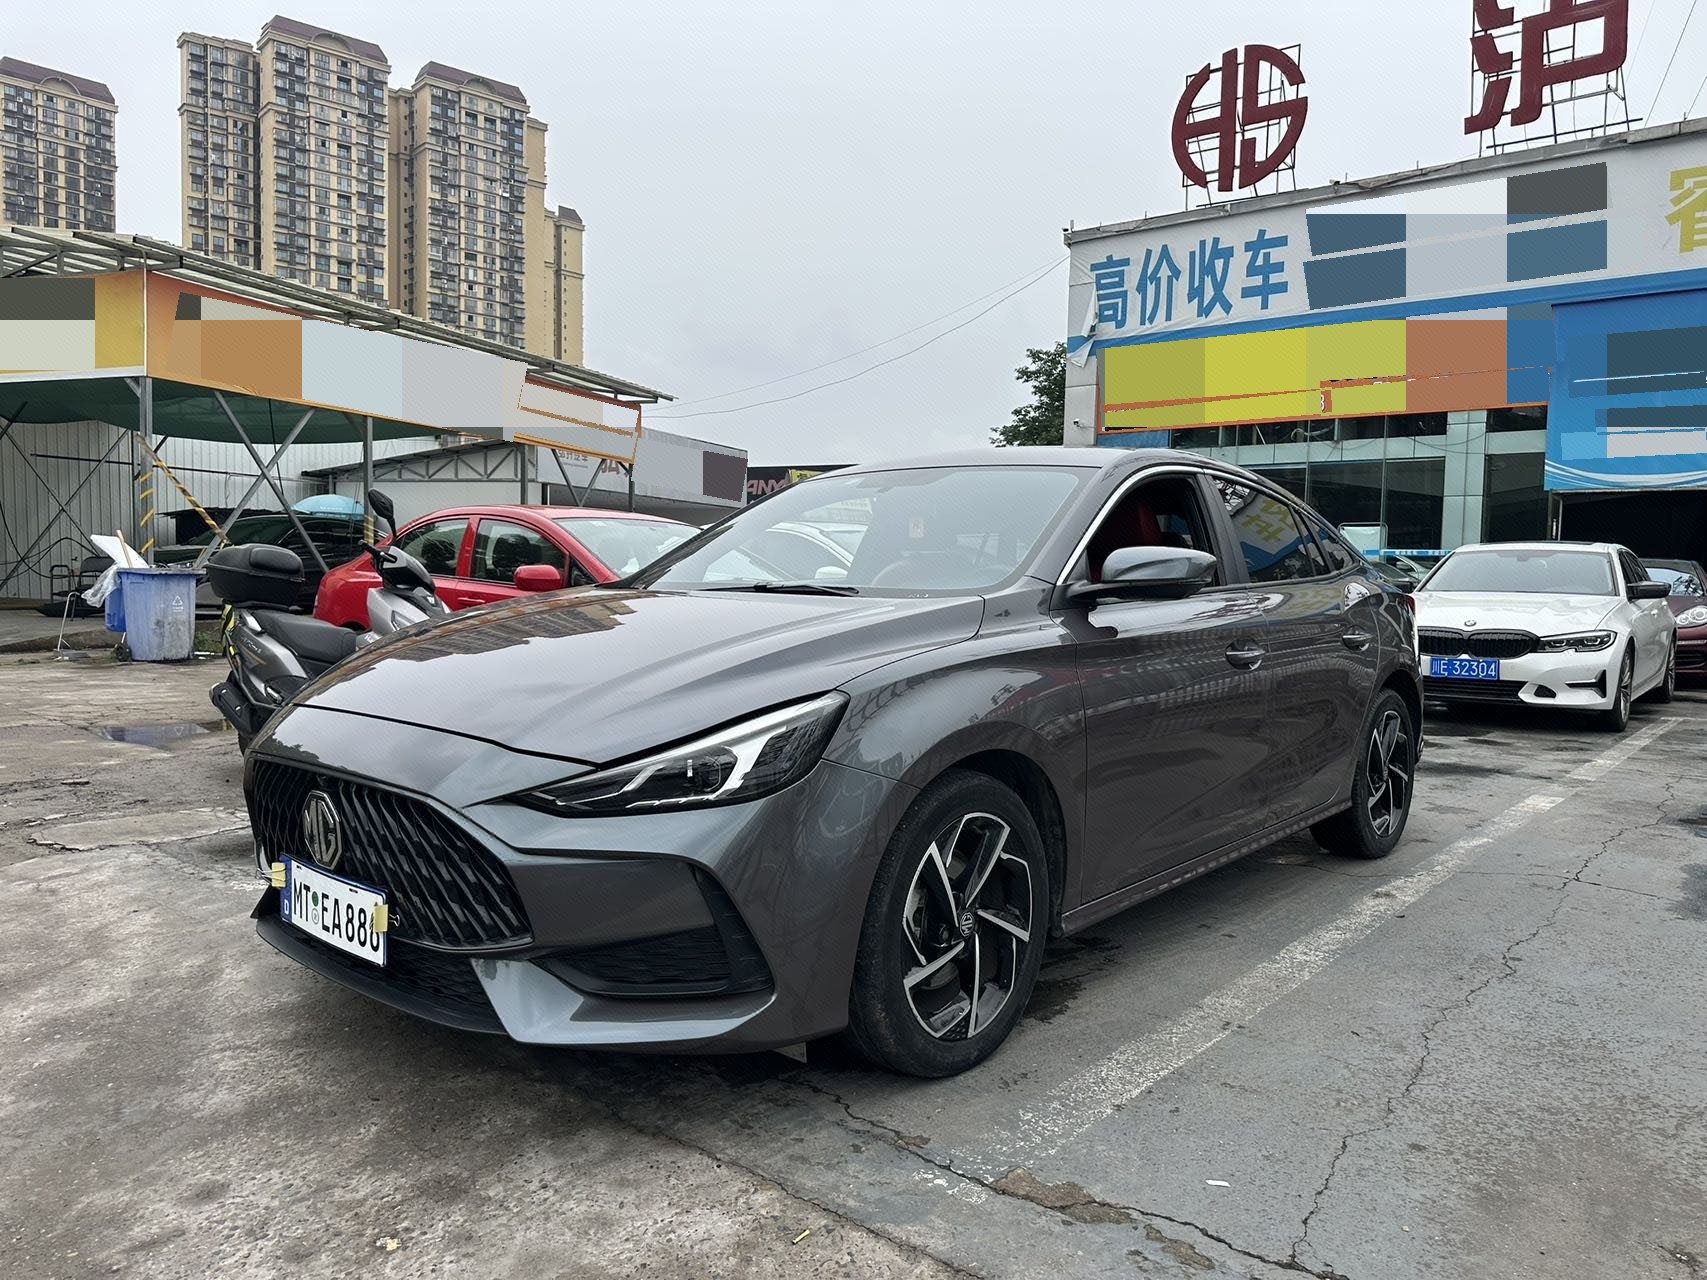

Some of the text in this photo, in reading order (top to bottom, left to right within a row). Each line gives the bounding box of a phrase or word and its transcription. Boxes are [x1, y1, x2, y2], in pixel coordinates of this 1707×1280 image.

[1090, 229, 1288, 329] 高价收车
[304, 798, 336, 864] MG
[294, 878, 311, 922] MT
